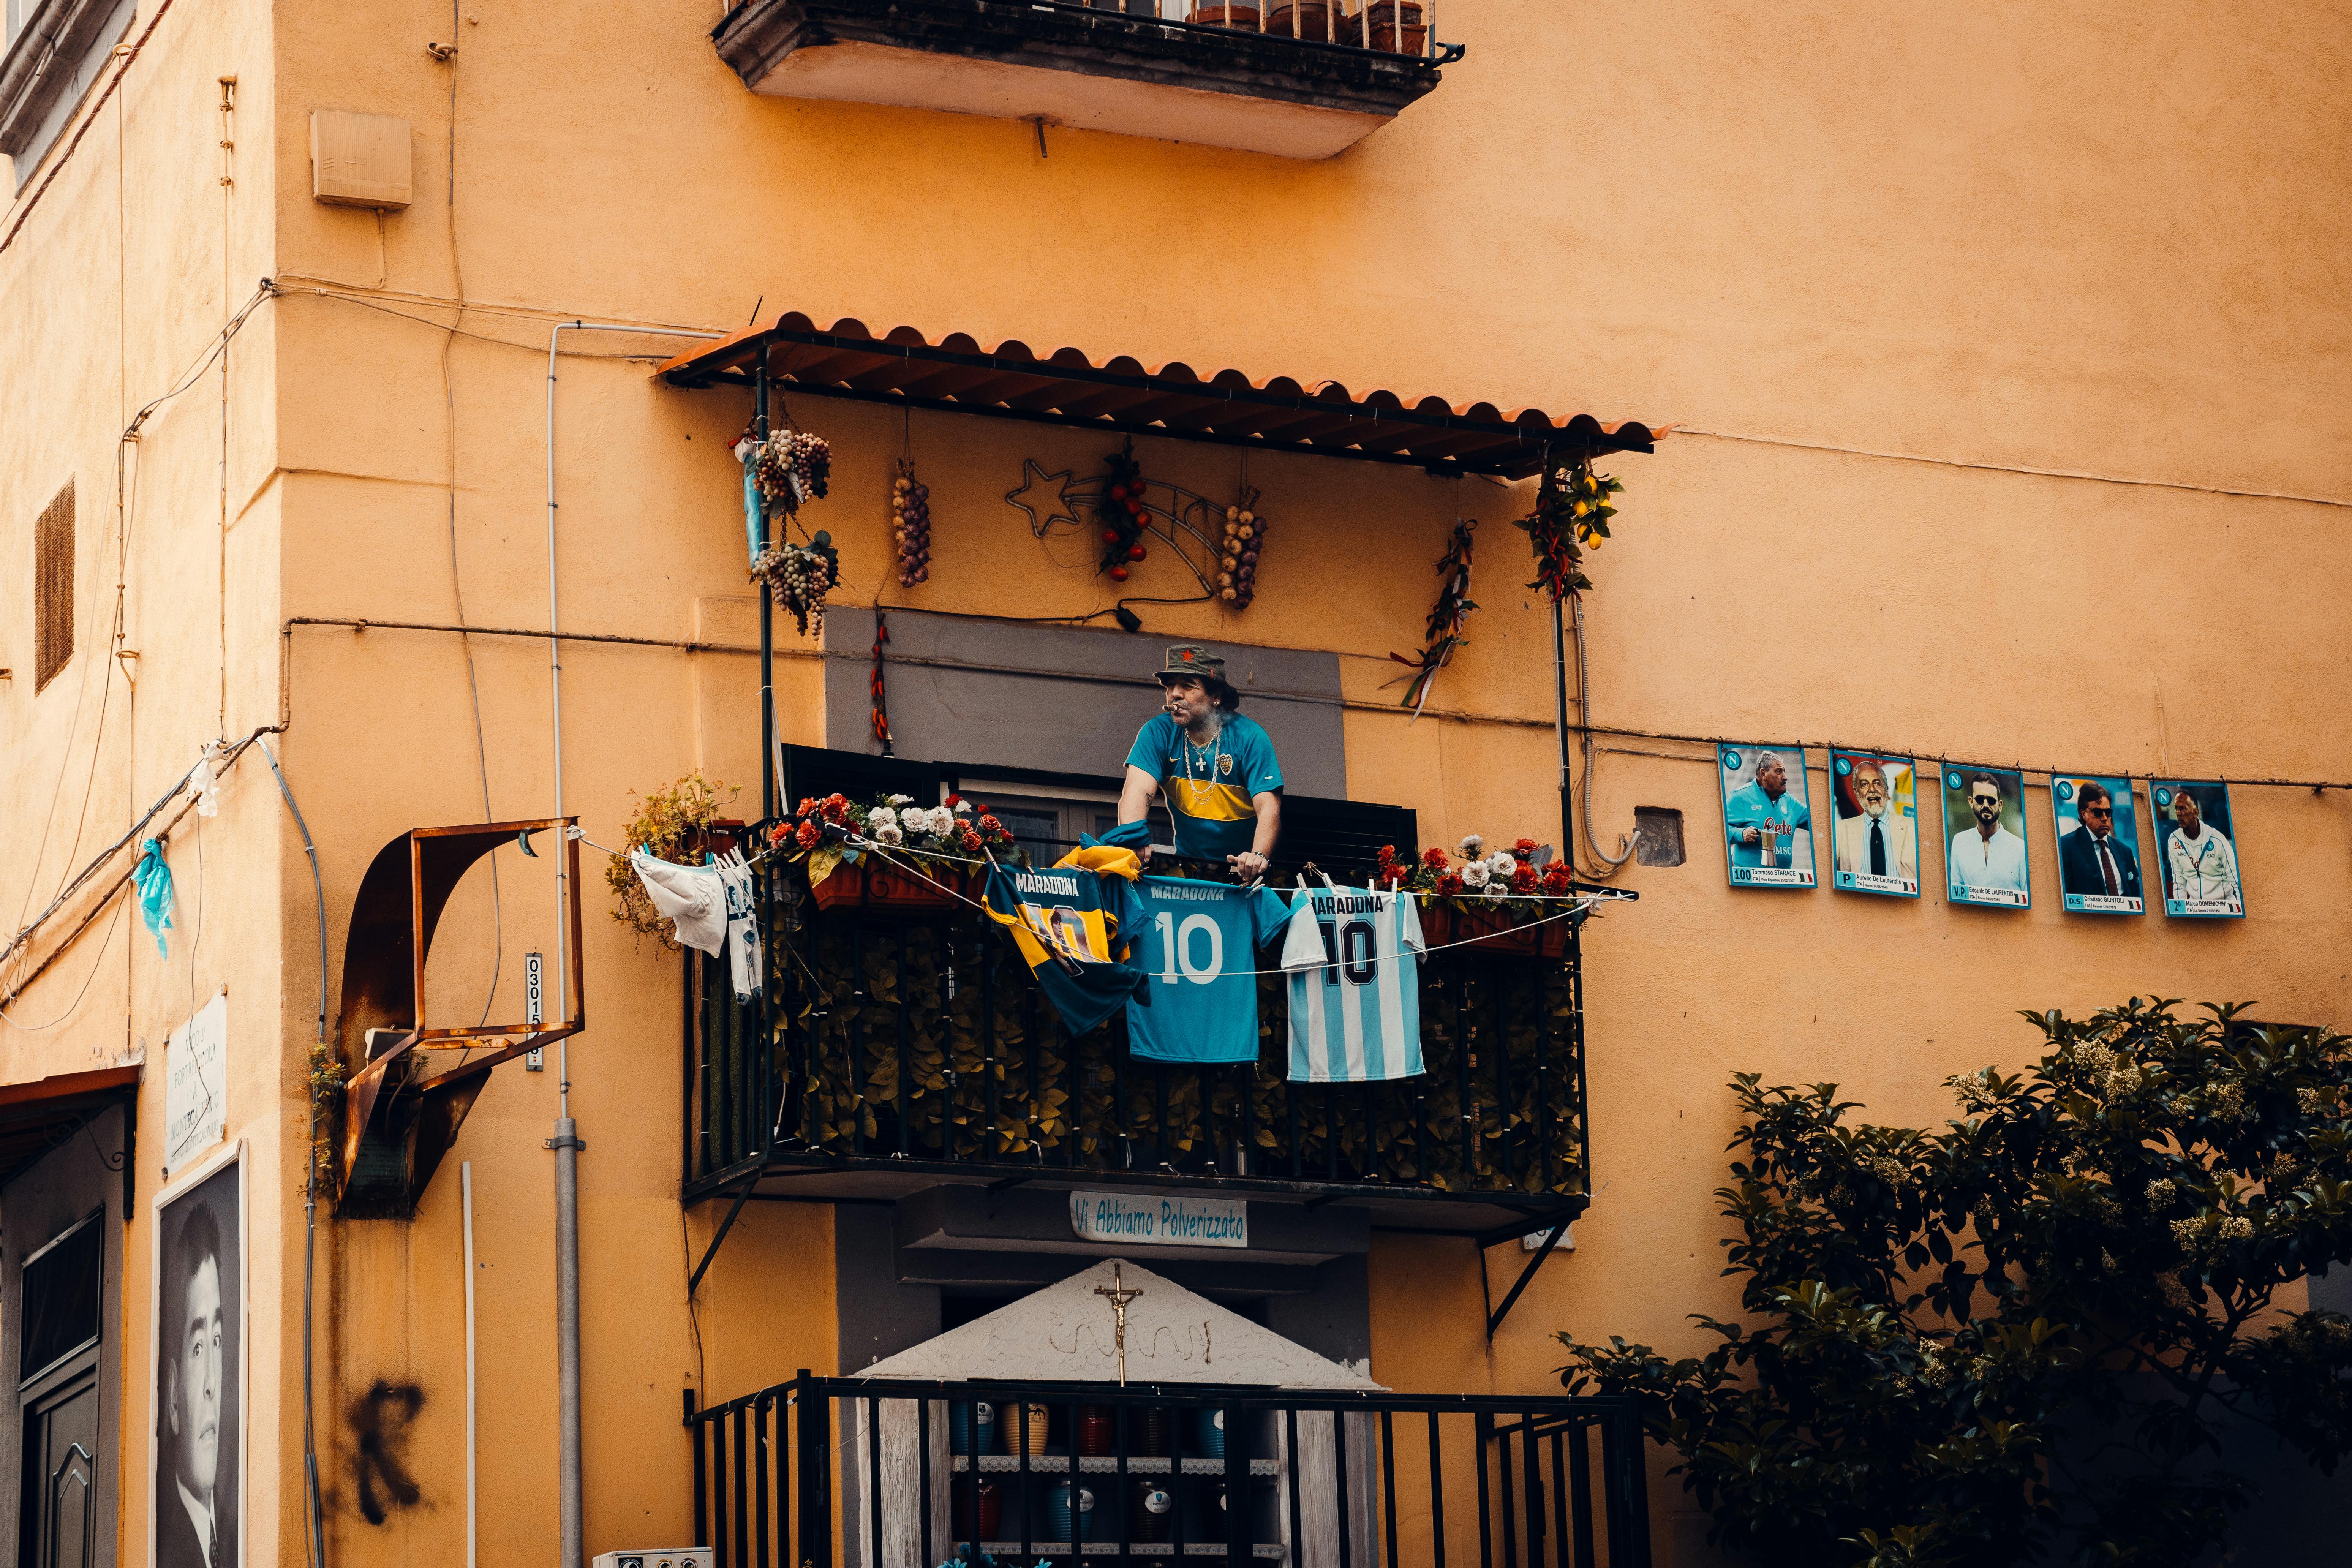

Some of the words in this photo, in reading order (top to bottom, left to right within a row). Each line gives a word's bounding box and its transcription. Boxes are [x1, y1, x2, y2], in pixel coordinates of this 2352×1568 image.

[1775, 846, 1792, 855] MSC
[1015, 873, 1079, 897] MARADONA
[1734, 869, 1751, 880] 100
[1843, 873, 1851, 884] P
[1151, 885, 1225, 901] MARADONA
[1954, 886, 1967, 898] V.P.
[1023, 900, 1095, 977] 10
[1155, 912, 1223, 985] 10
[1317, 919, 1378, 987] 10
[175, 1042, 216, 1089] PORTAPICCOLA
[193, 1081, 197, 1099] A
[171, 1091, 219, 1141] MONTECALVARIO
[1075, 1198, 1089, 1233] Vi
[1095, 1199, 1154, 1236] Abbiamo
[1160, 1199, 1244, 1240] Polverizzato
